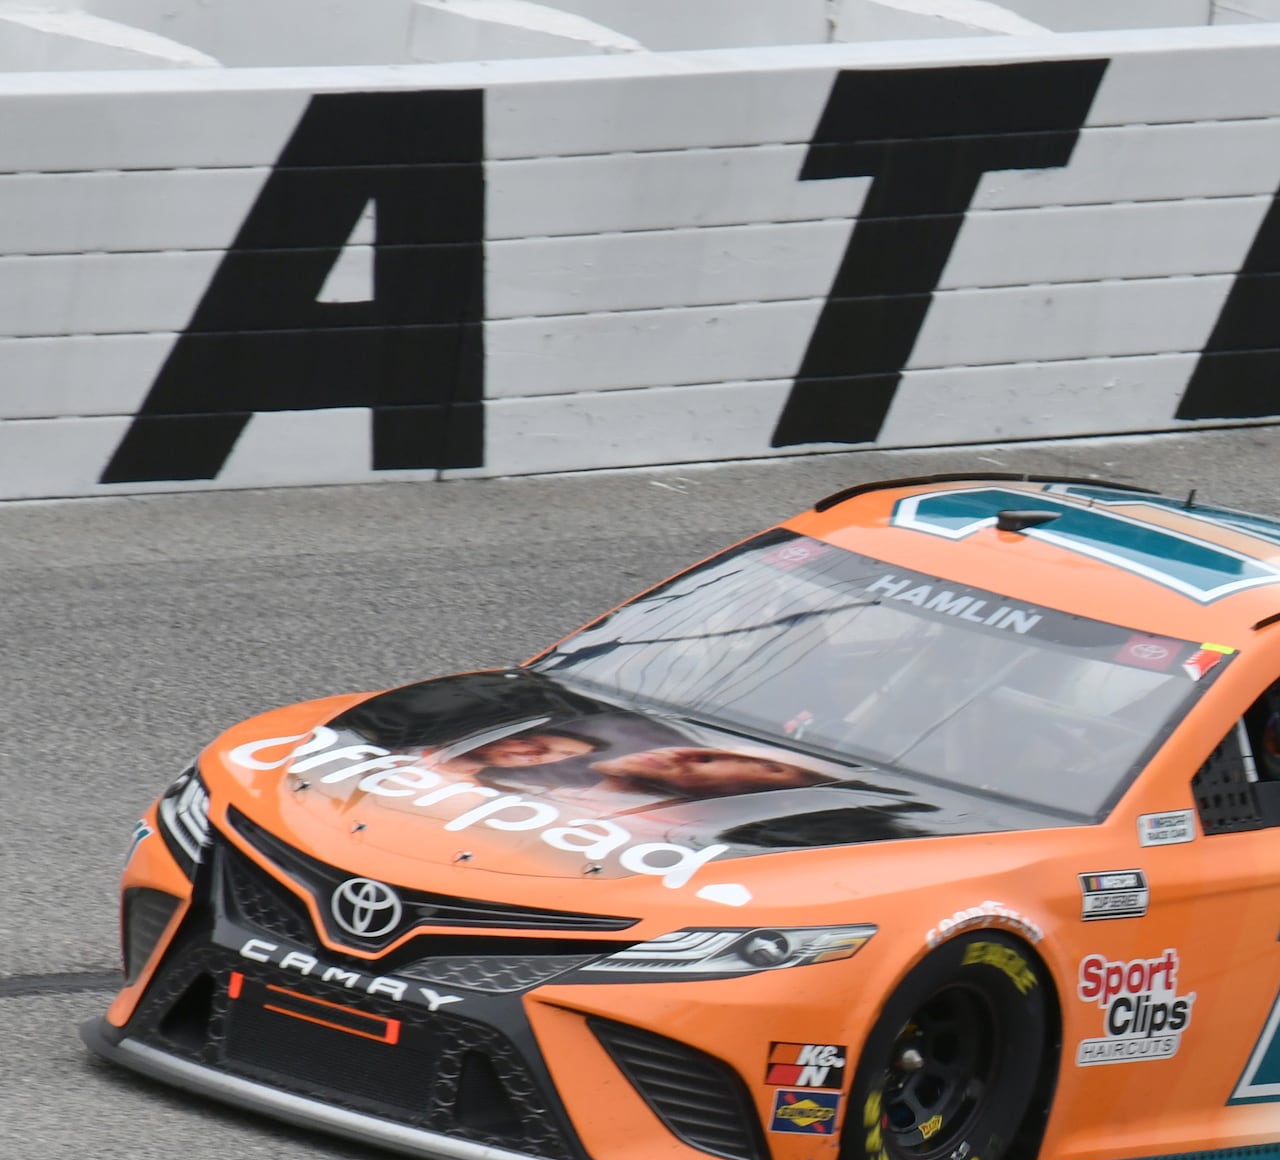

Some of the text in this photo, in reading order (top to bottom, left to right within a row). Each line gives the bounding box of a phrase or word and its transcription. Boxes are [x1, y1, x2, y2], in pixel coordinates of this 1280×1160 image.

[864, 574, 1043, 634] HAMLIN
[229, 725, 730, 889] Offerpad
[1081, 952, 1175, 1005] Sport
[1107, 995, 1189, 1039] Clips
[1082, 1037, 1172, 1059] HAIRCUTS
